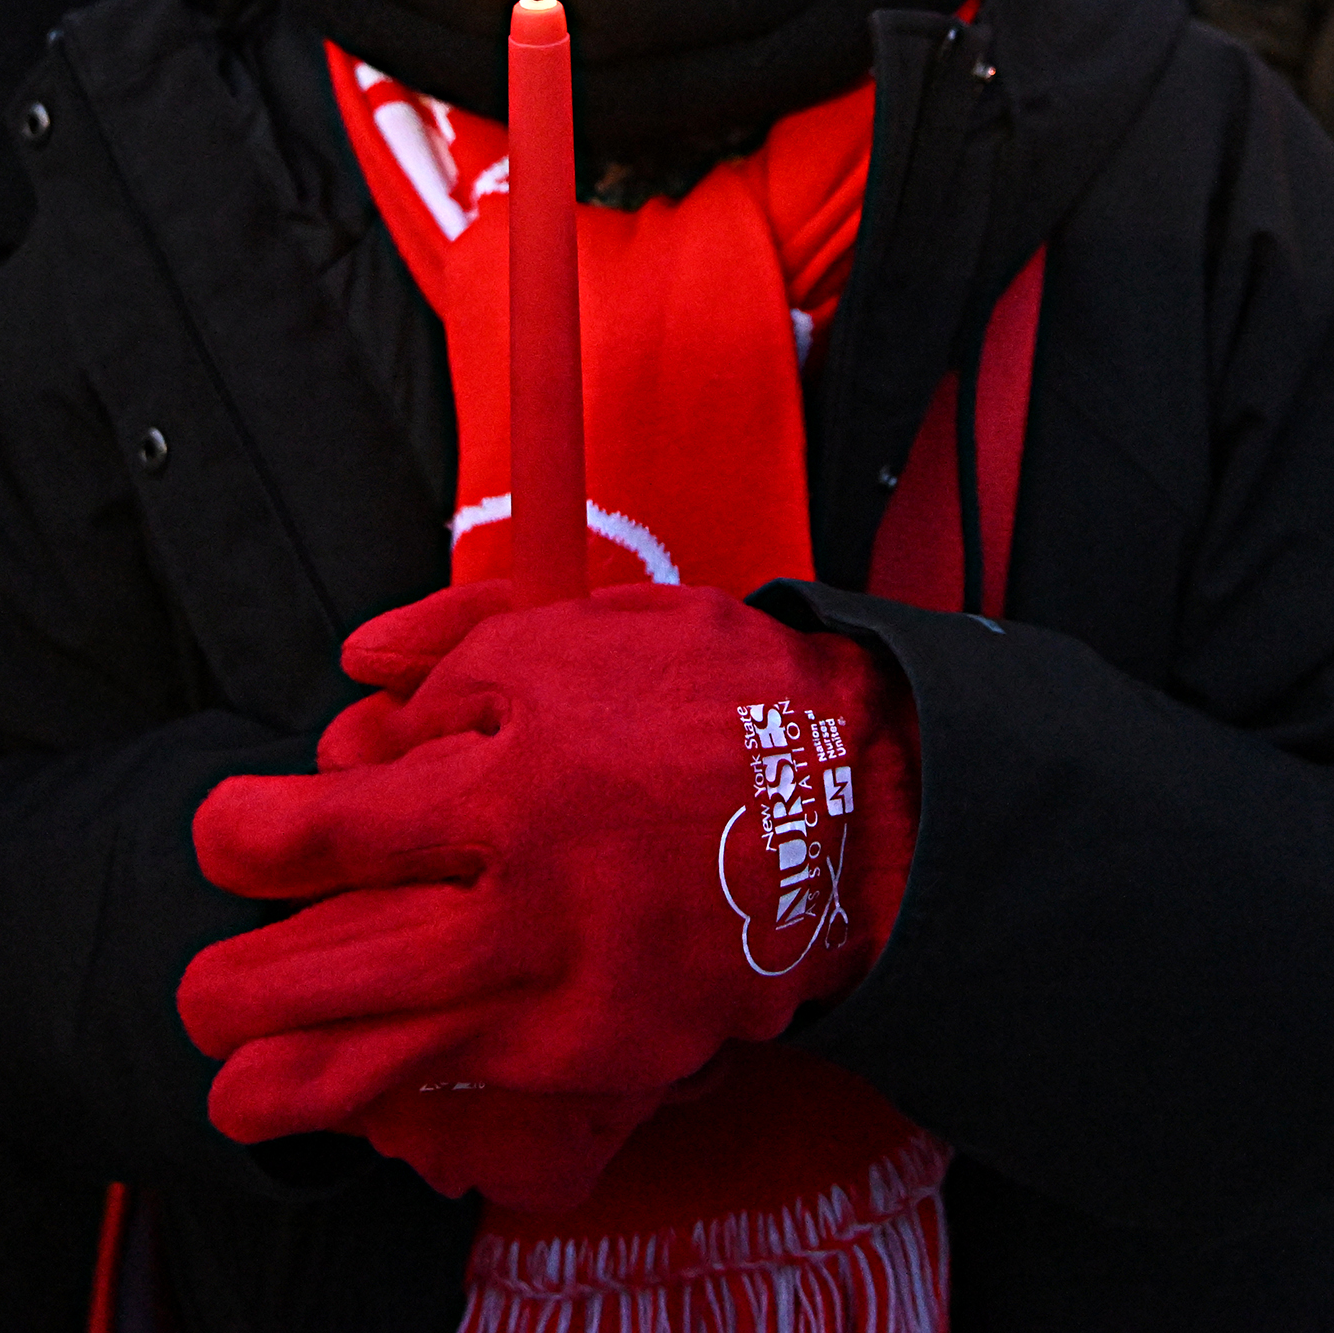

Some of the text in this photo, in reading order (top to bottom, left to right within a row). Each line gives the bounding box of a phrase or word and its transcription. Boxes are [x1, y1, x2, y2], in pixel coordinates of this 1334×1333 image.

[736, 705, 777, 852] New York State
[778, 700, 822, 918] ASSOCIATION
[818, 719, 837, 759] Nurses
[825, 718, 847, 757] United
[749, 702, 809, 931] NURSES
